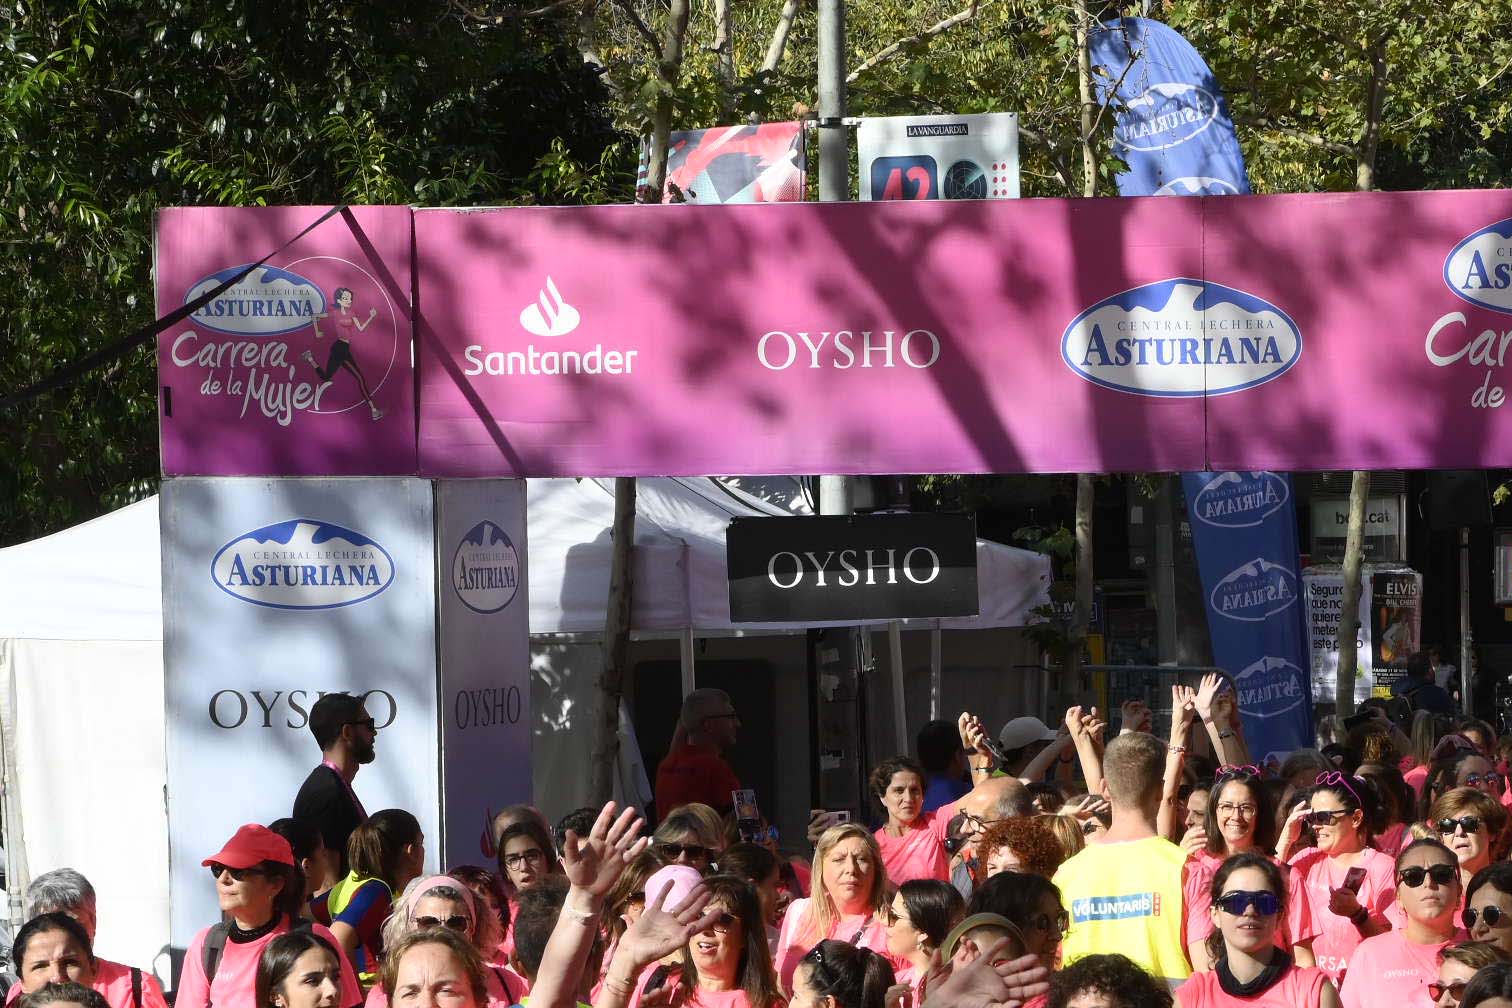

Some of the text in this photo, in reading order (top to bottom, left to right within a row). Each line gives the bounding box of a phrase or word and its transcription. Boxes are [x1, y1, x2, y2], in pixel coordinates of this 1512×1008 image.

[1117, 318, 1275, 332] CENTRAL LECHERA
[171, 330, 289, 368] Carrera
[464, 342, 637, 376] Santander
[757, 329, 941, 370] OYSHO
[1080, 323, 1284, 366] ASTURIANA
[201, 364, 334, 426] de la Mujer
[1471, 369, 1505, 408] de
[227, 553, 382, 587] ASTURIANA
[253, 551, 311, 560] CENTRAL
[458, 556, 516, 591] ASTURIANA
[767, 547, 940, 588] OYSHO
[1386, 582, 1418, 596] ELVIS
[455, 685, 521, 730] OYSHO
[1073, 897, 1151, 917] VOLUNTARIS
